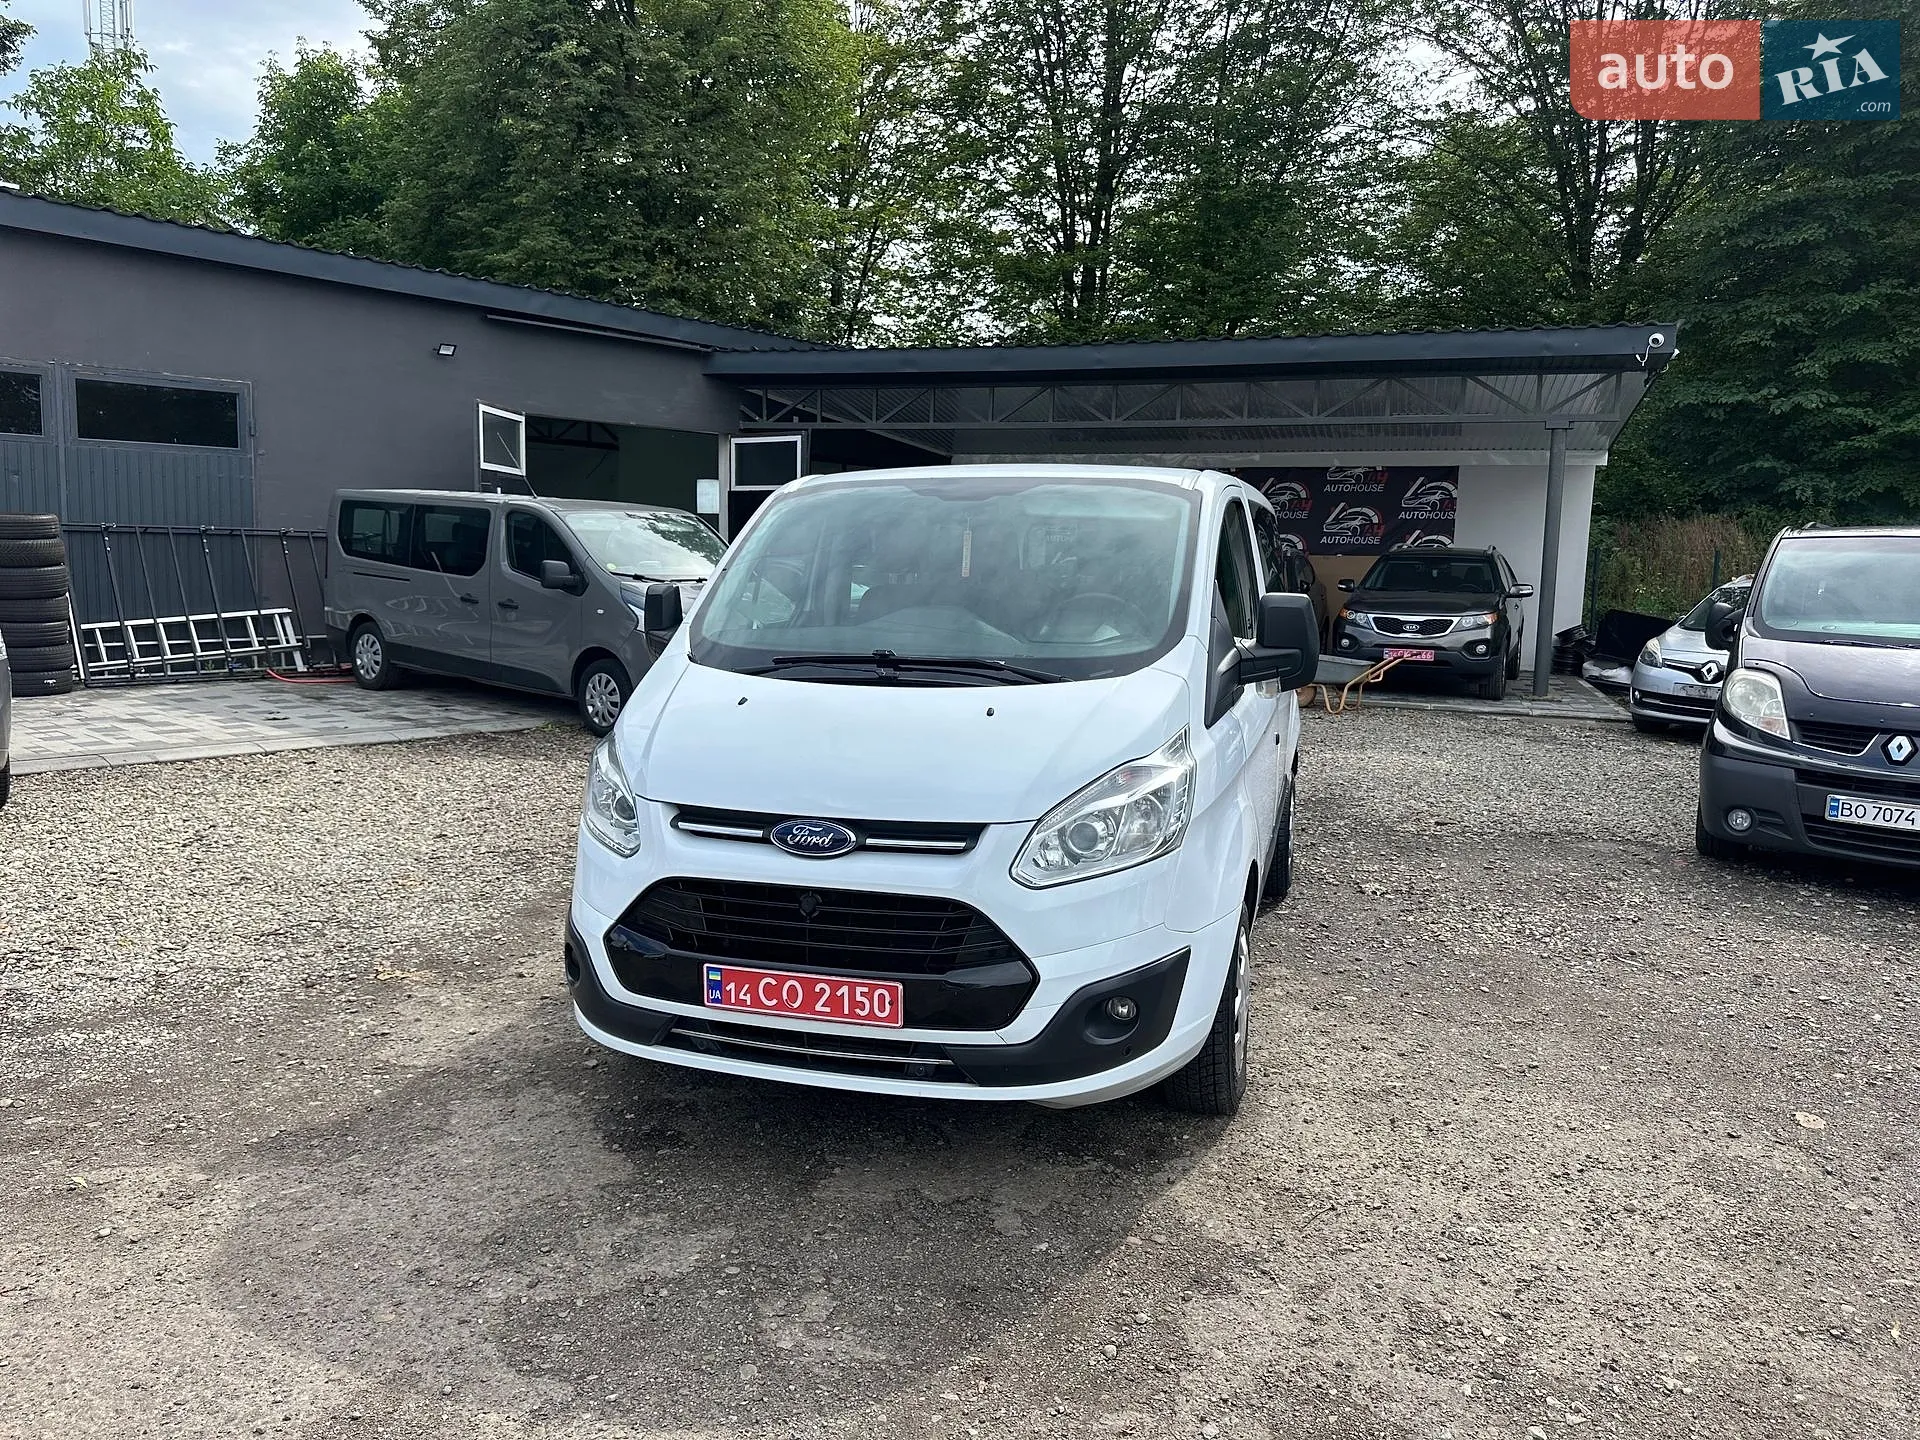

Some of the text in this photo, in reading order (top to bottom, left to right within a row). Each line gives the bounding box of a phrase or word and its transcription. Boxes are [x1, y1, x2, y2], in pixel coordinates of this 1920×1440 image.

[1323, 483, 1385, 493] AUTOHOUSE
[1276, 511, 1309, 520] HOUSE
[1398, 511, 1457, 520] AUTOHOUS
[1319, 536, 1382, 545] AUTOHOUSE
[1840, 801, 1916, 826] BO 7074
[786, 824, 834, 848] Ford
[708, 989, 722, 1000] UA
[725, 977, 893, 1018] 14 CO 2150
